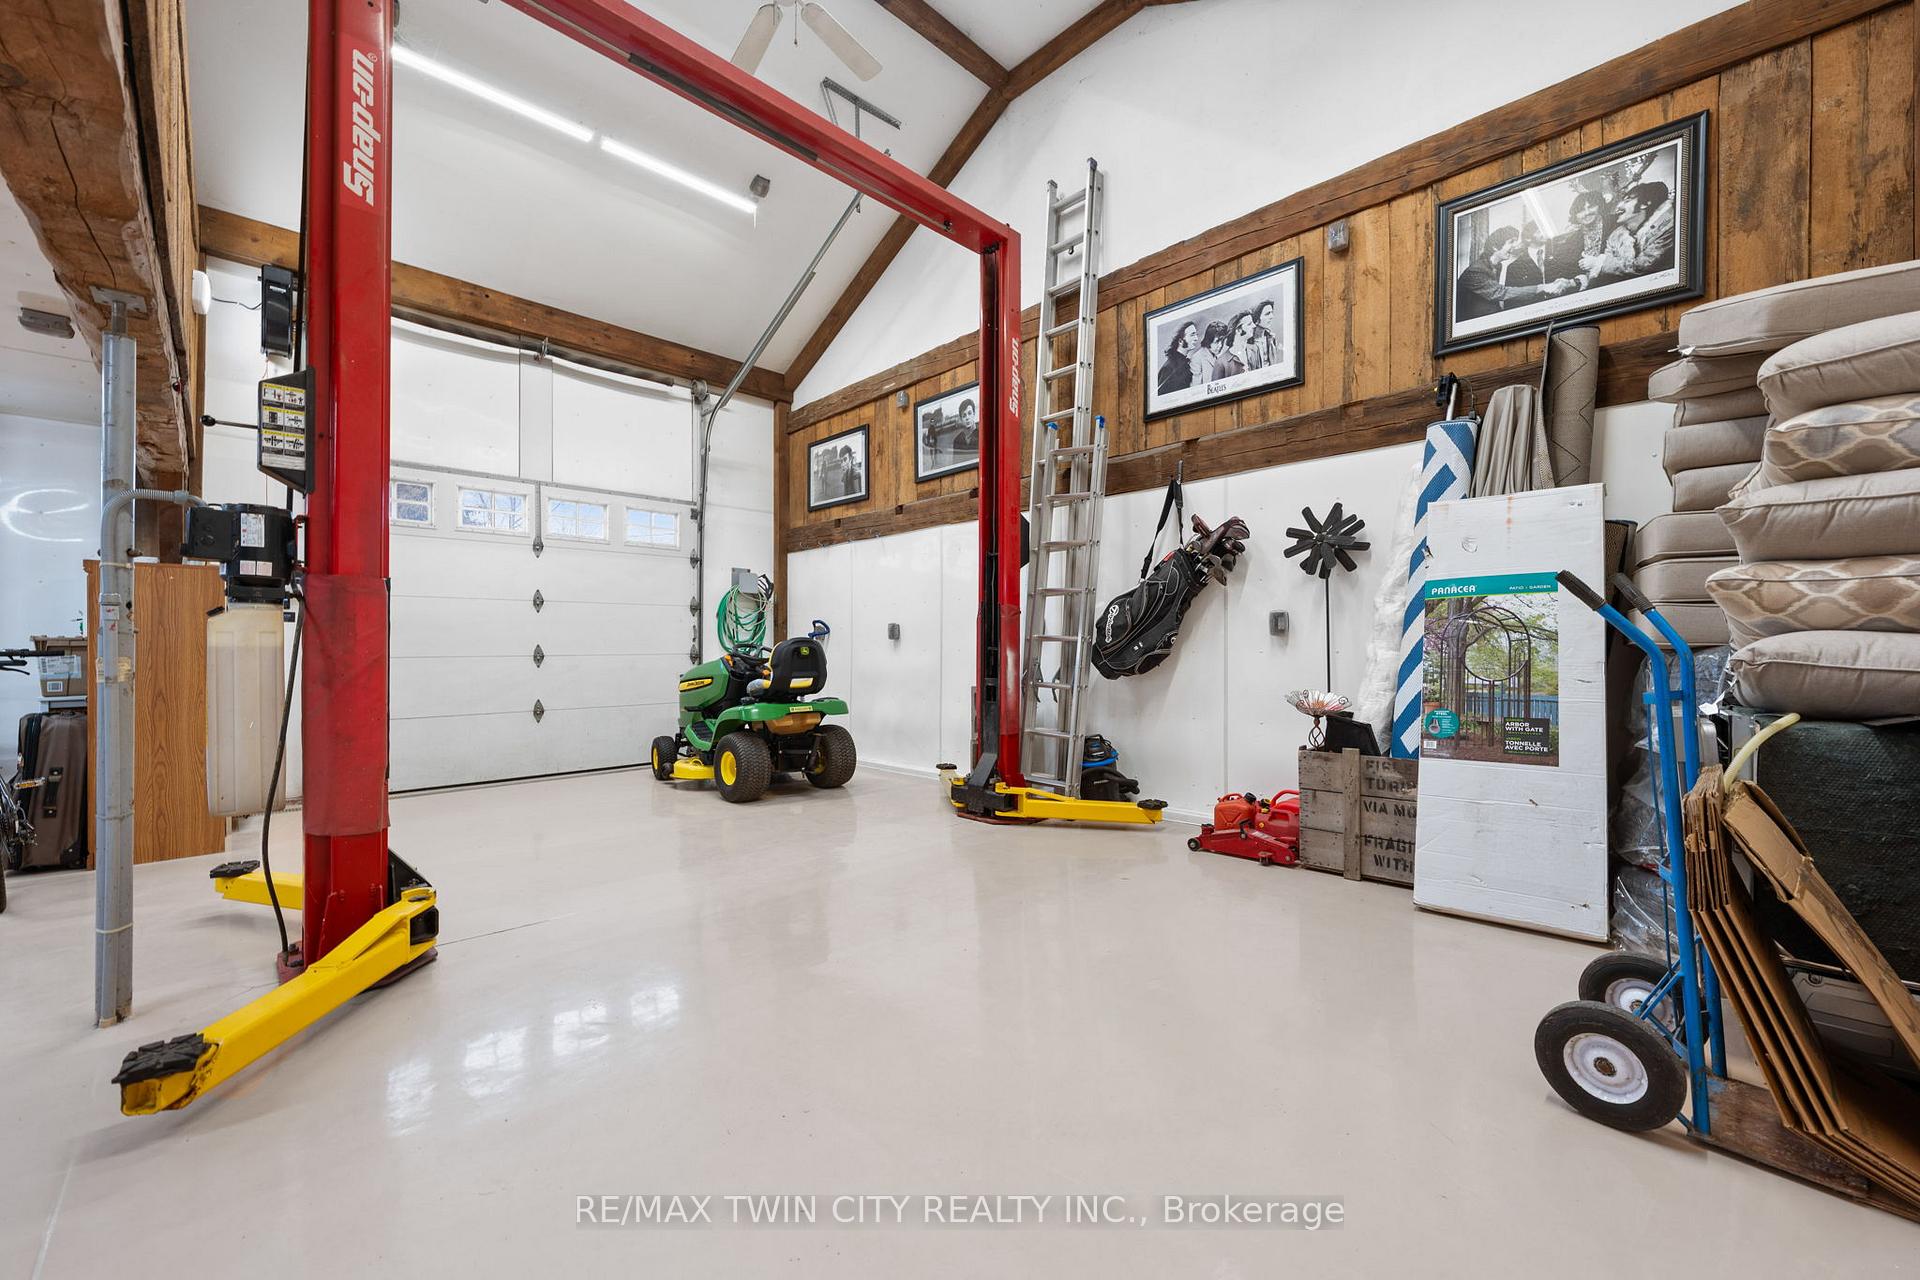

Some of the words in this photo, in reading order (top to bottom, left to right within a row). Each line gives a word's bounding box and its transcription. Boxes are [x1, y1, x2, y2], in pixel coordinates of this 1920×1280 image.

[343, 49, 381, 207] Snap-on
[1009, 337, 1020, 418] Snap-on
[1363, 800, 1388, 816] VIA
